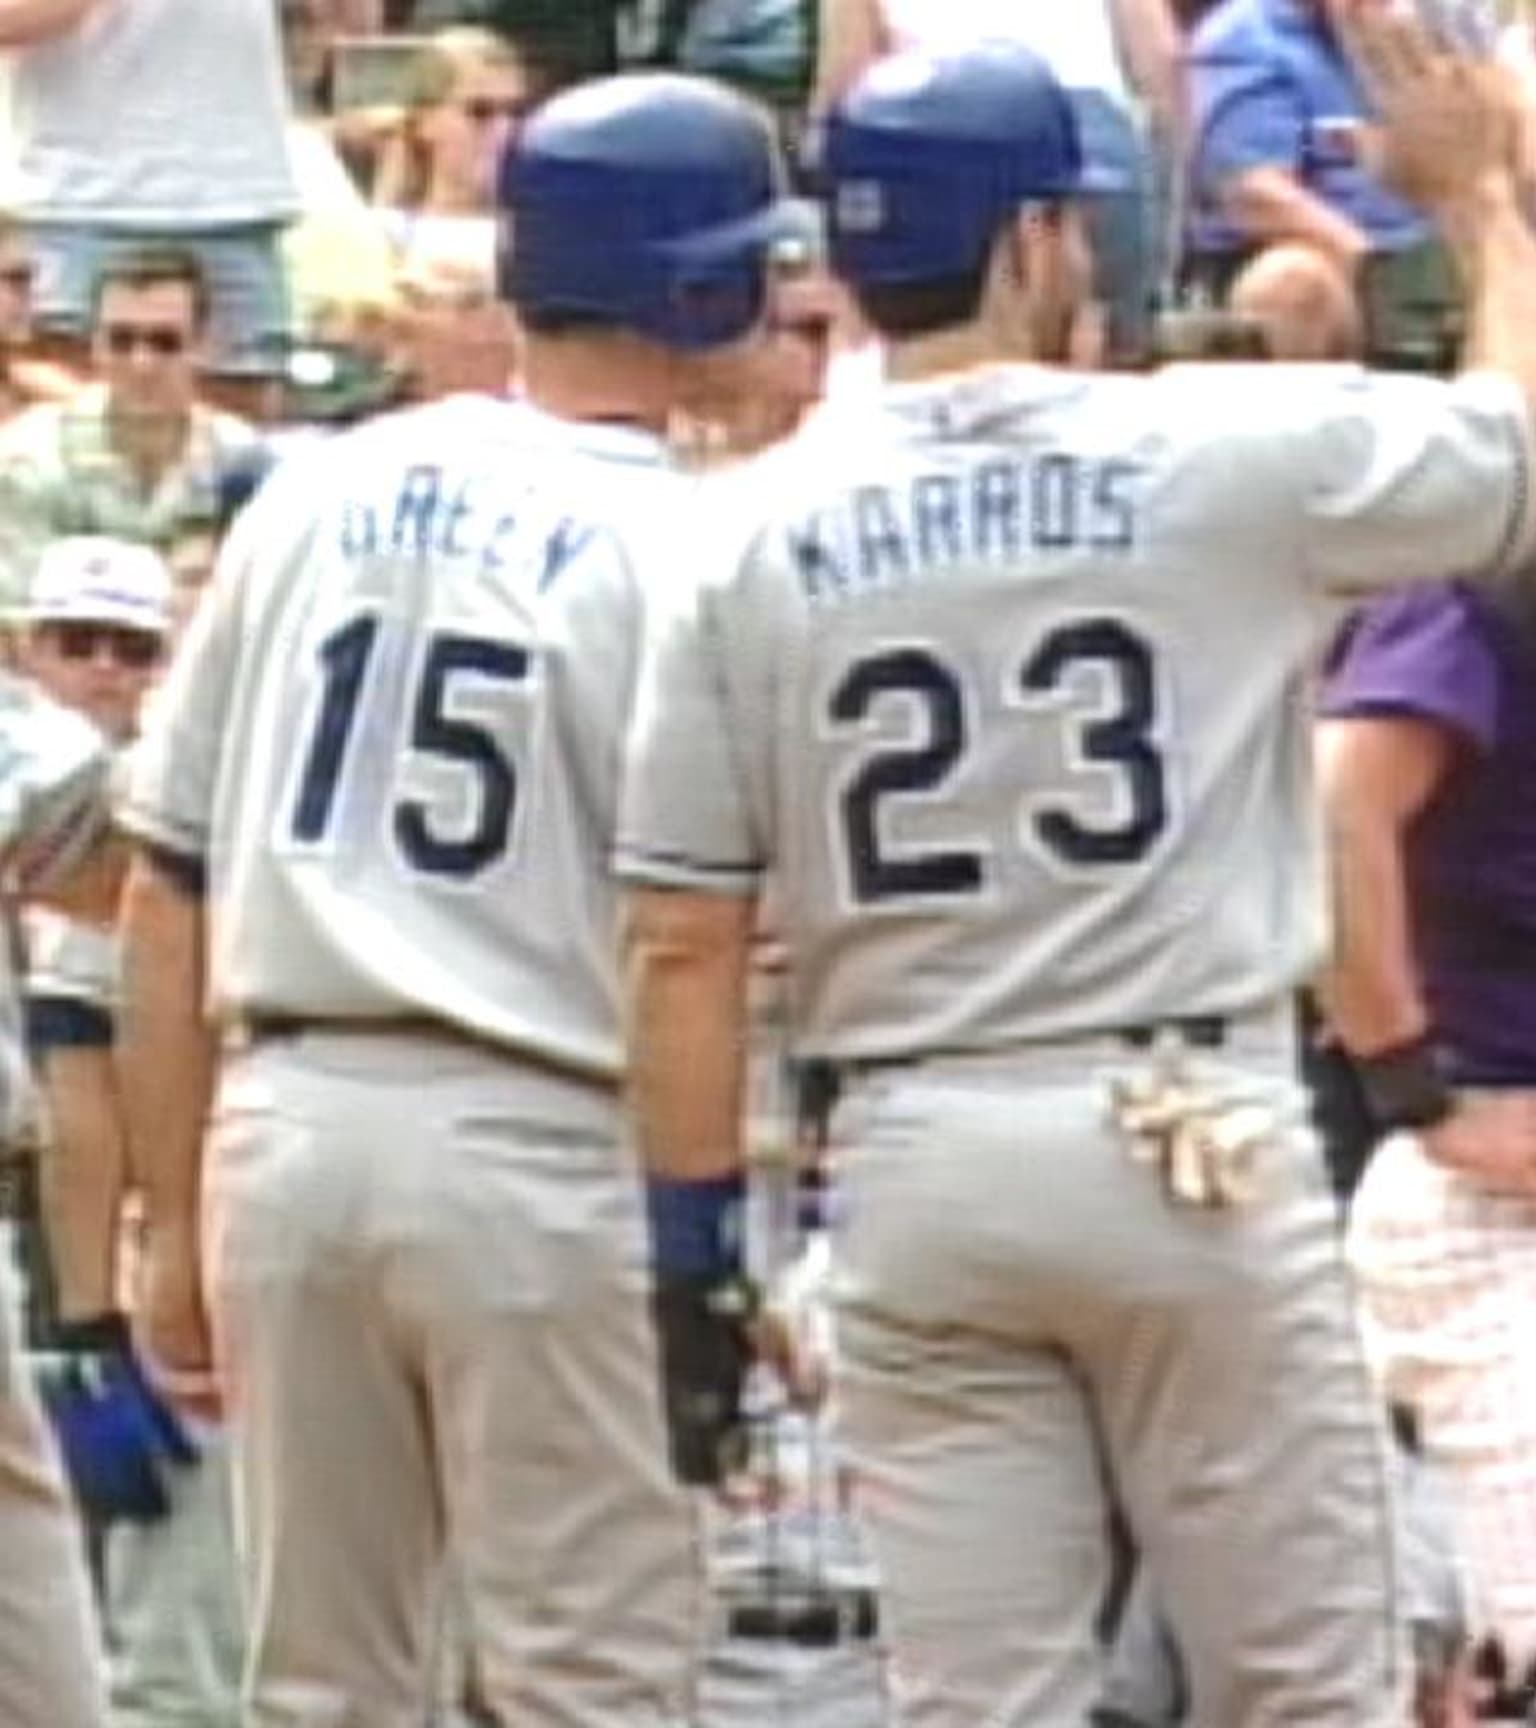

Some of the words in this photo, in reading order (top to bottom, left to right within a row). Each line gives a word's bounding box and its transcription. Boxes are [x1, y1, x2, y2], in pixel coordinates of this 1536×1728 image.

[784, 452, 1144, 600] KARROS
[288, 610, 534, 882] 15
[826, 616, 1168, 902] 23
